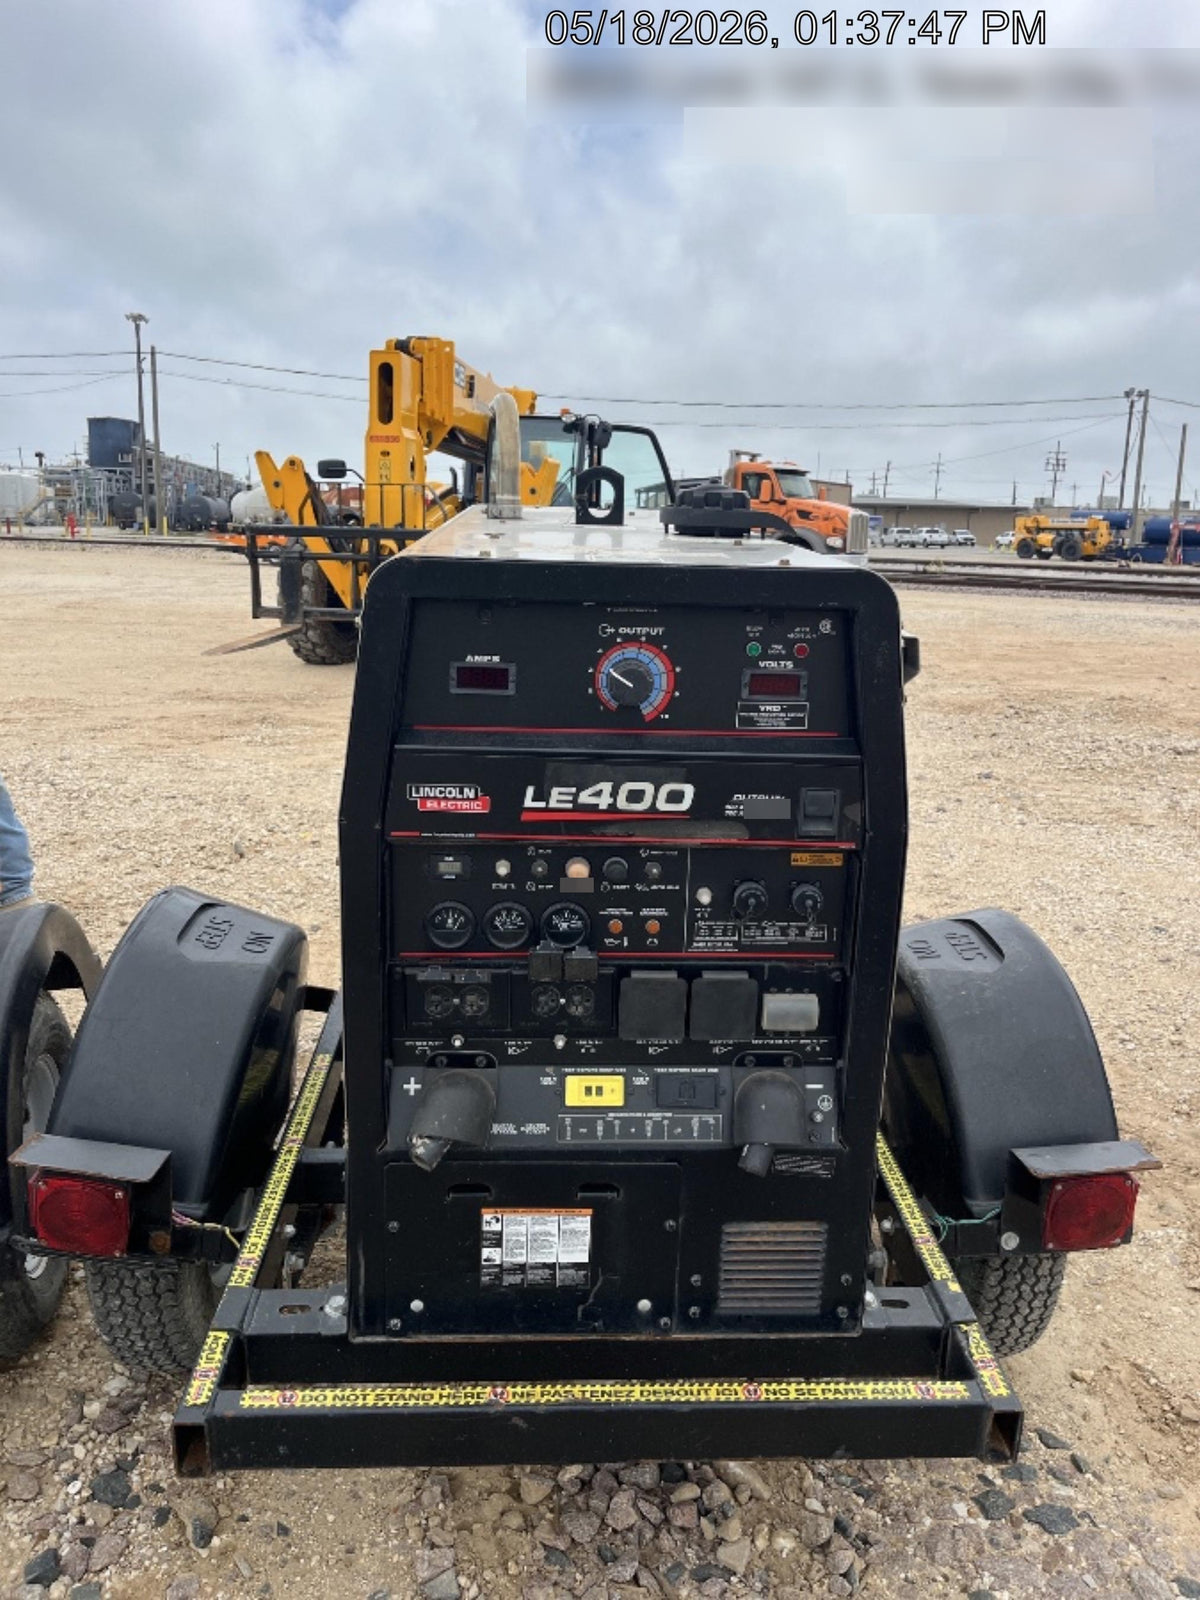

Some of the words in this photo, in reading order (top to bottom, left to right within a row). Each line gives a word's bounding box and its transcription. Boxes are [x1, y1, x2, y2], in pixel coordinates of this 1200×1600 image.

[618, 627, 665, 636] OUTPUT
[465, 655, 500, 663] AMPS
[759, 660, 794, 669] VOLTS
[412, 786, 475, 799] LINCOLN
[523, 781, 695, 811] LE400
[426, 800, 482, 810] ELECTRIC
[195, 916, 234, 950] STEP
[944, 932, 987, 961] STEP
[301, 1393, 327, 1403] DO
[332, 1393, 370, 1402] NOT
[374, 1392, 434, 1402] STAND
[439, 1391, 486, 1401] HERE
[512, 1390, 536, 1399] NE
[540, 1389, 574, 1399] PAS
[579, 1389, 635, 1398] TENEZ
[640, 1388, 711, 1397] DEBOUT
[716, 1388, 738, 1396] ICI
[765, 1387, 791, 1396] NO
[795, 1387, 817, 1396] SE
[821, 1387, 866, 1396] PARE
